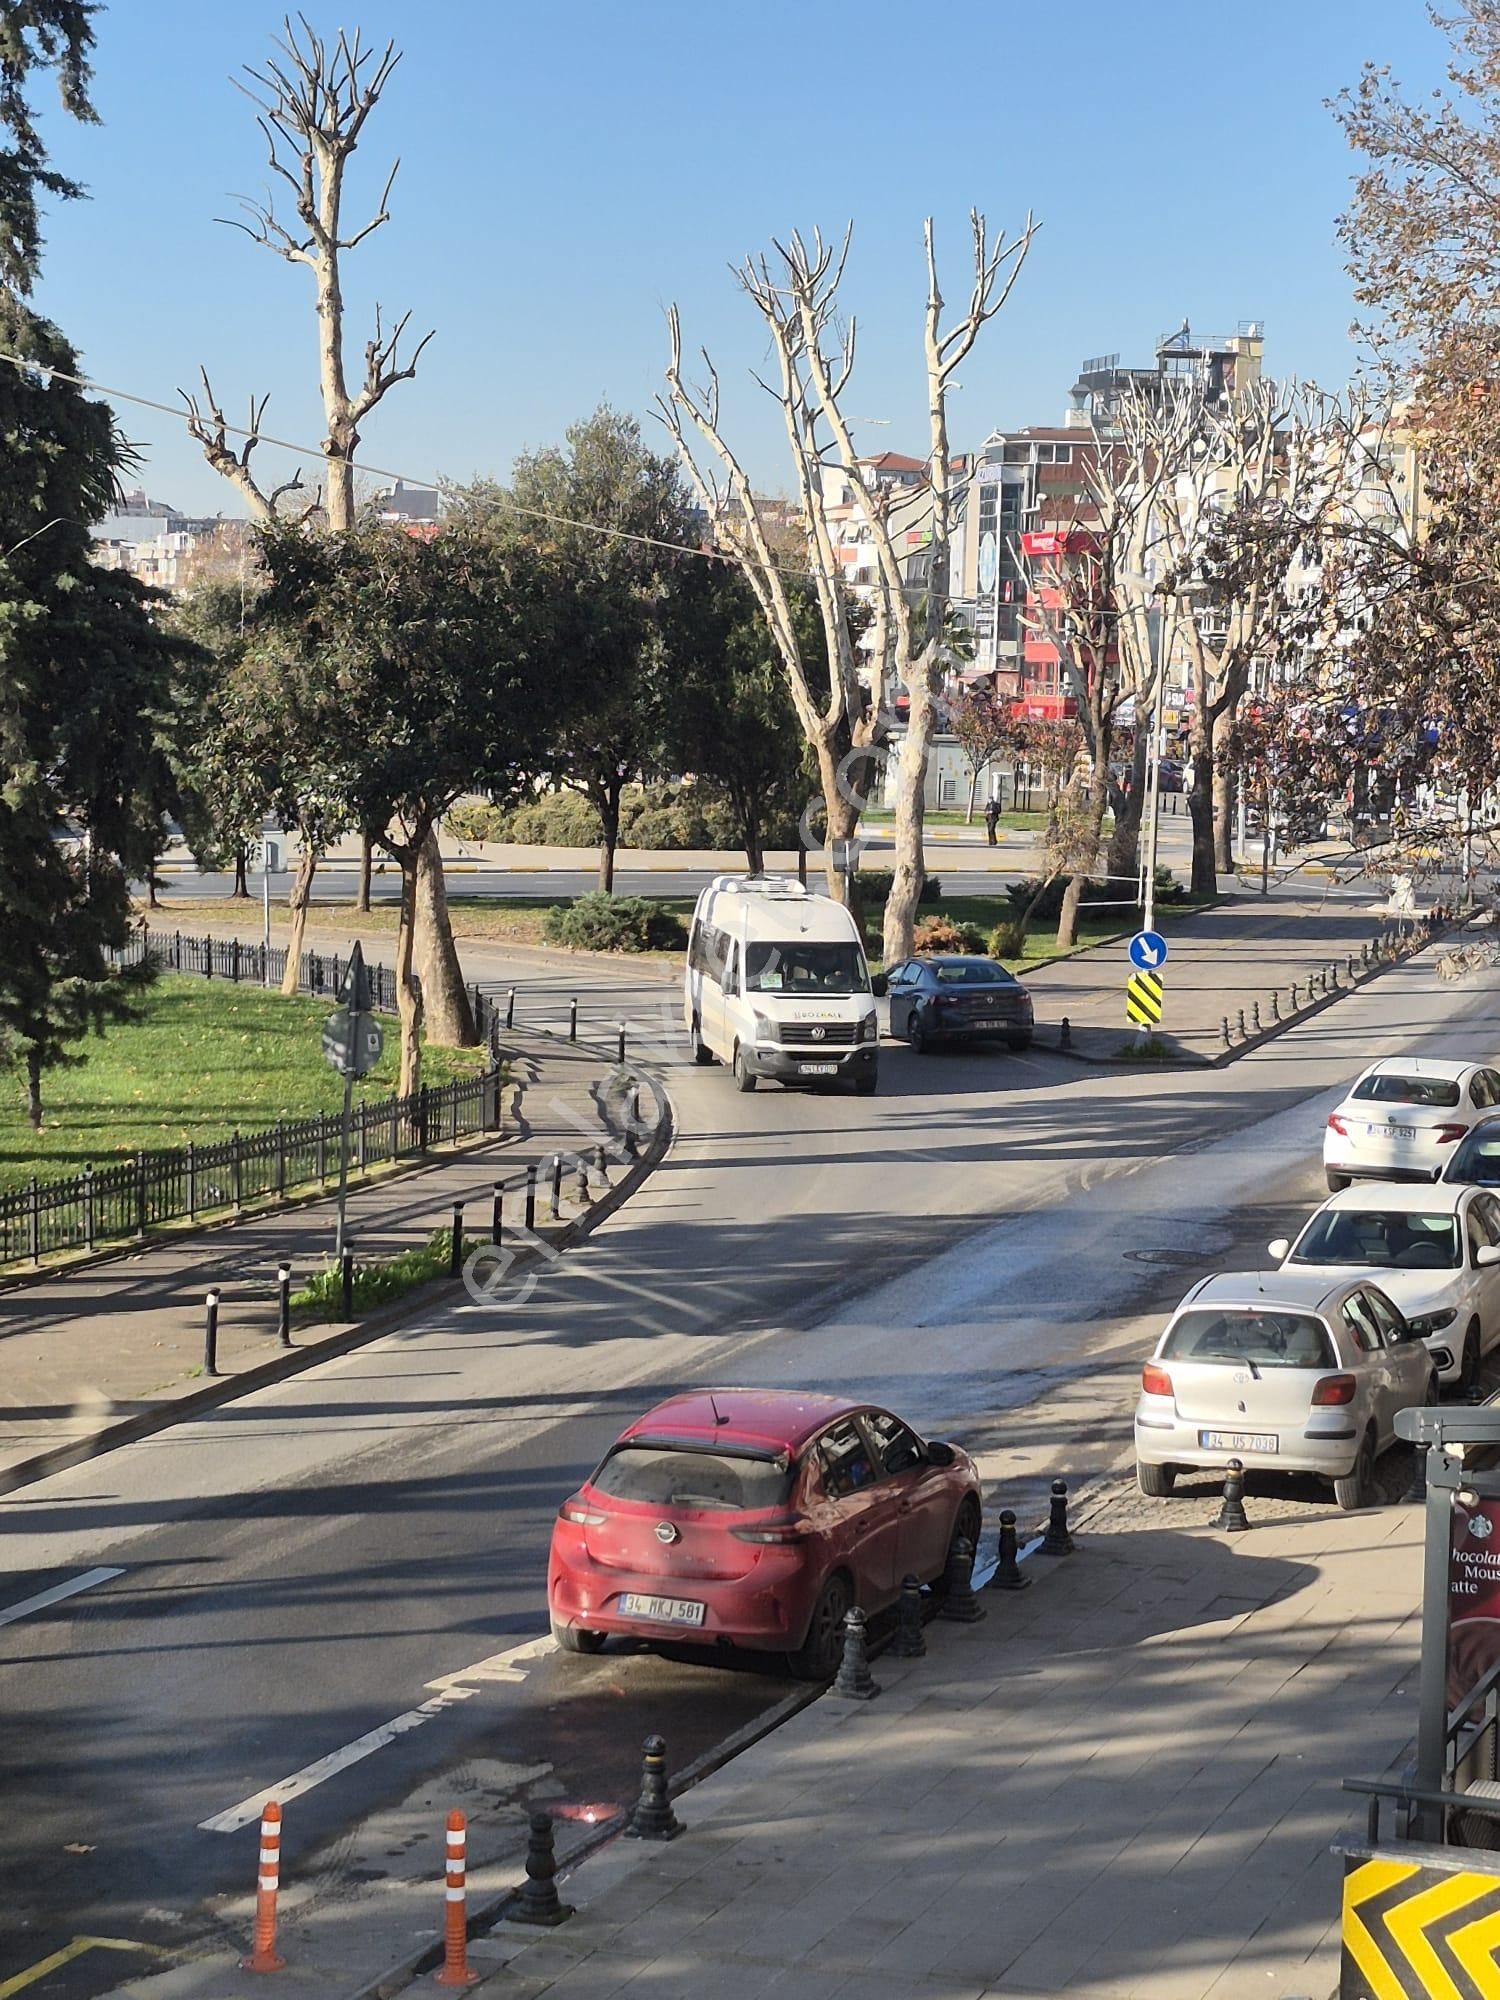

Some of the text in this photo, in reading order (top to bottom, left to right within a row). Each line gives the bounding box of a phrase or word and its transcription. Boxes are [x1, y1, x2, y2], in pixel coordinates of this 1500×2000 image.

[1211, 1433, 1223, 1448] 34
[1232, 1435, 1246, 1449] US
[1452, 1547, 1500, 1566] hocolat
[1451, 1580, 1479, 1594] atte
[627, 1595, 702, 1620] 34 MKJ 581
